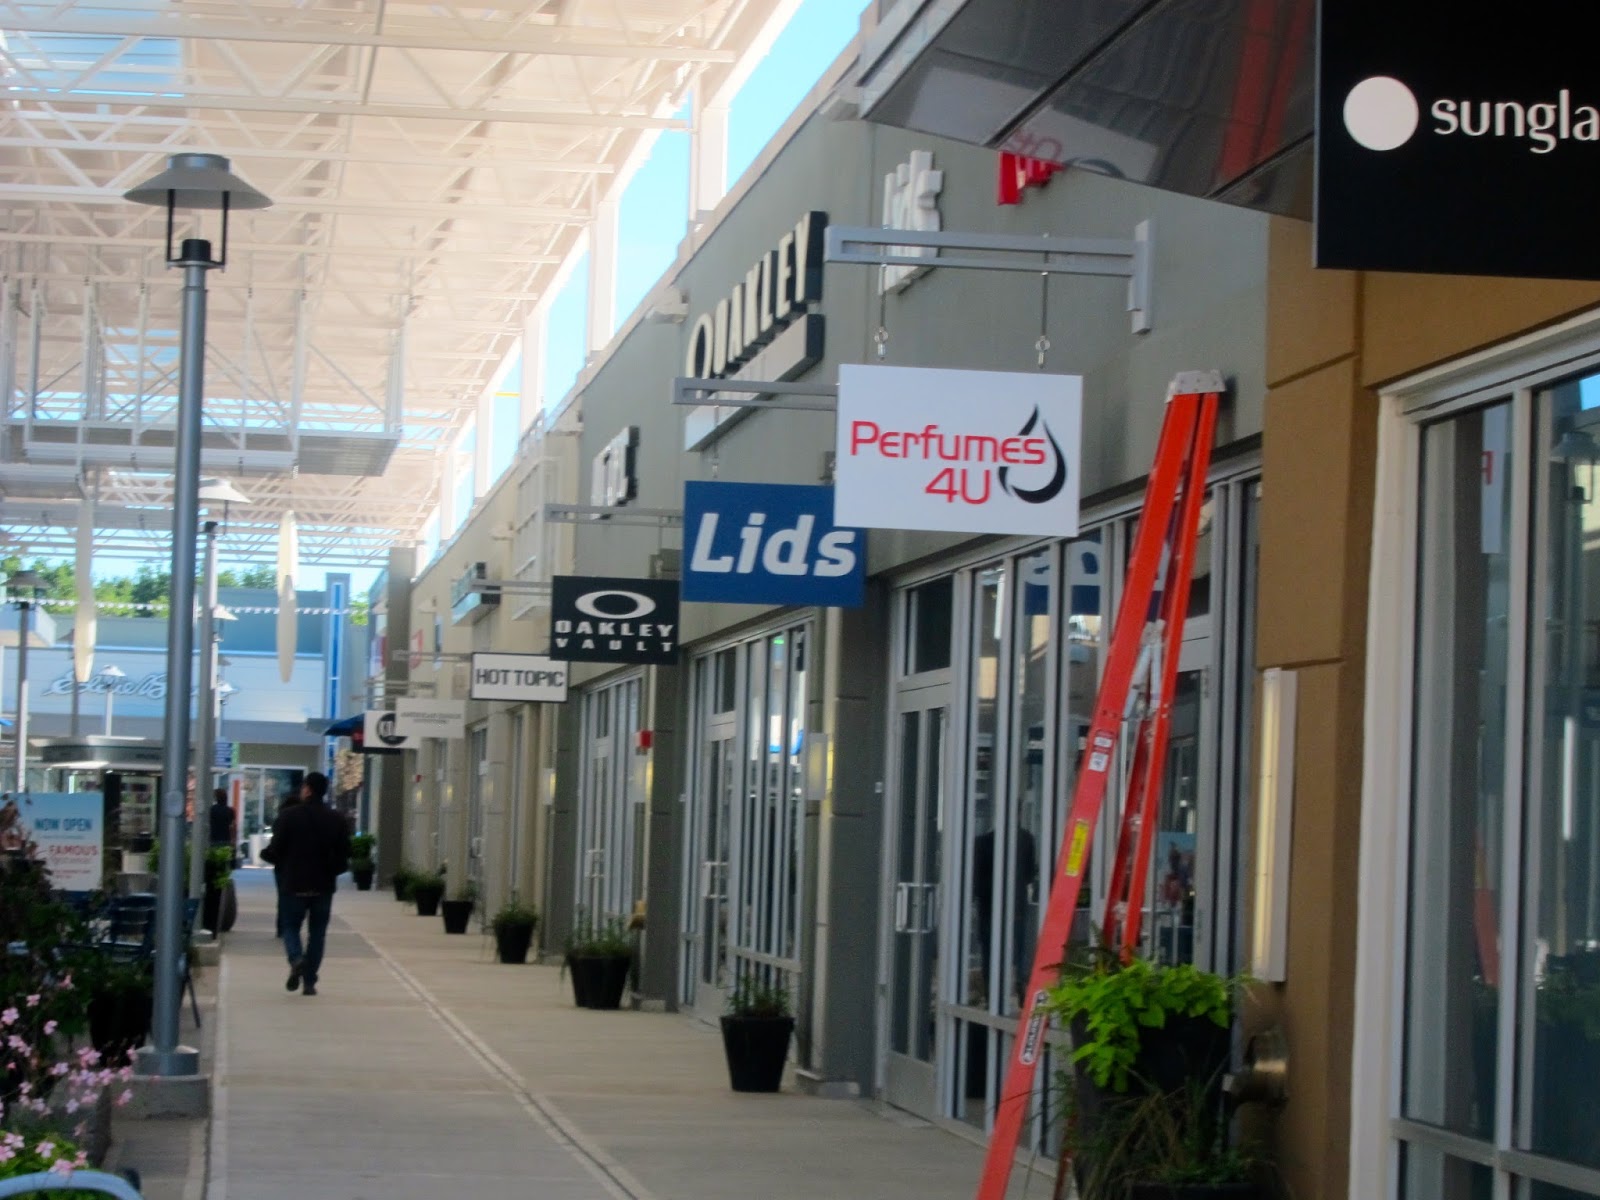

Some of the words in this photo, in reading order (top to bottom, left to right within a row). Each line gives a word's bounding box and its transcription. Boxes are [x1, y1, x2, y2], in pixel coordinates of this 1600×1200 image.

[1430, 87, 1600, 155] sungla
[849, 419, 1048, 466] Perfumes
[924, 466, 992, 506] 4U
[689, 511, 858, 578] Lids
[554, 619, 675, 638] OAKLEY
[554, 637, 674, 653] VAULT
[475, 668, 511, 686] HOT
[514, 669, 564, 687] TOPIC
[34, 817, 60, 831] NOW
[63, 817, 93, 832] OPEN
[49, 844, 98, 856] FAMOUS
